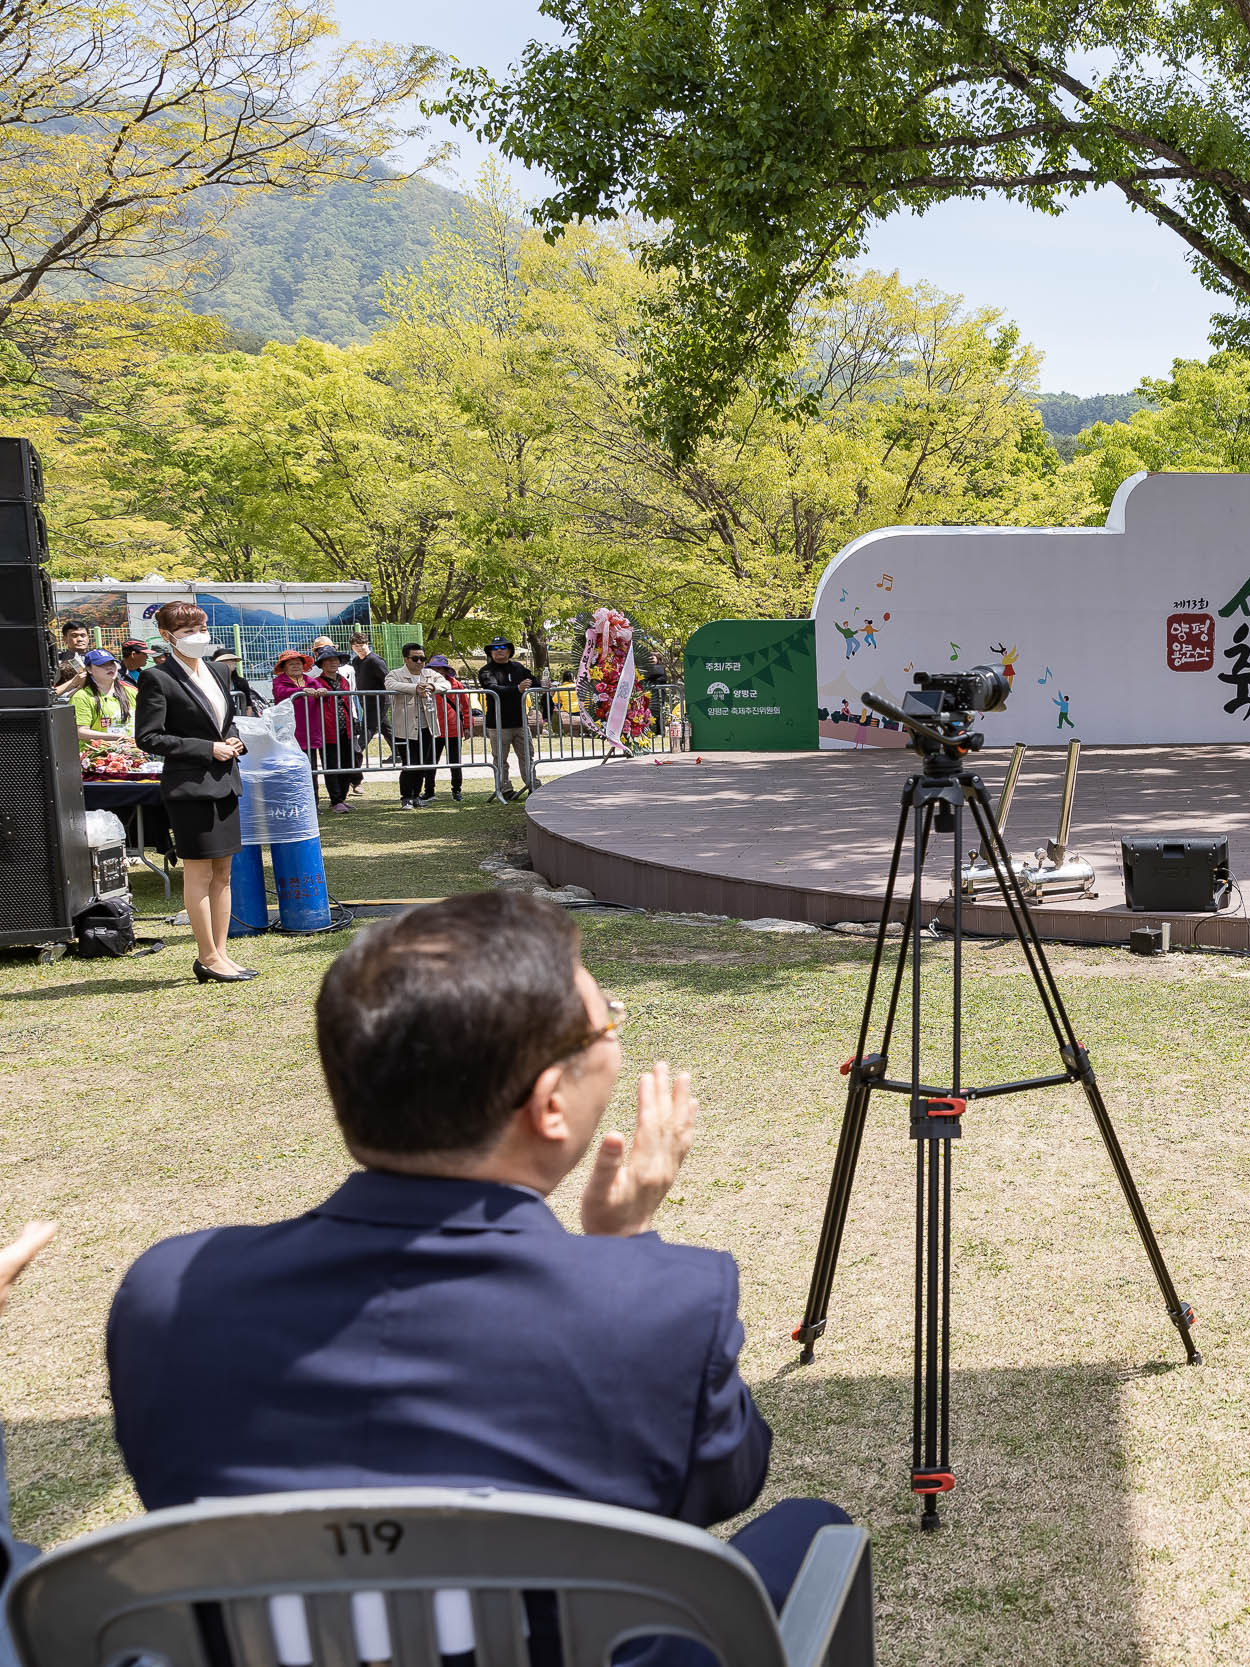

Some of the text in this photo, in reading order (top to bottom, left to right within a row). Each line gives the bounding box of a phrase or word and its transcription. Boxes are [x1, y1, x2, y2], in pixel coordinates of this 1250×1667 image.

[1173, 597, 1209, 610] 제13회
[1170, 619, 1210, 641] 양평
[1171, 642, 1211, 667] 용문산
[705, 662, 741, 672] 주최/주관
[733, 689, 758, 698] 양평군
[707, 707, 729, 716] 양평군
[323, 1520, 404, 1556] 119
